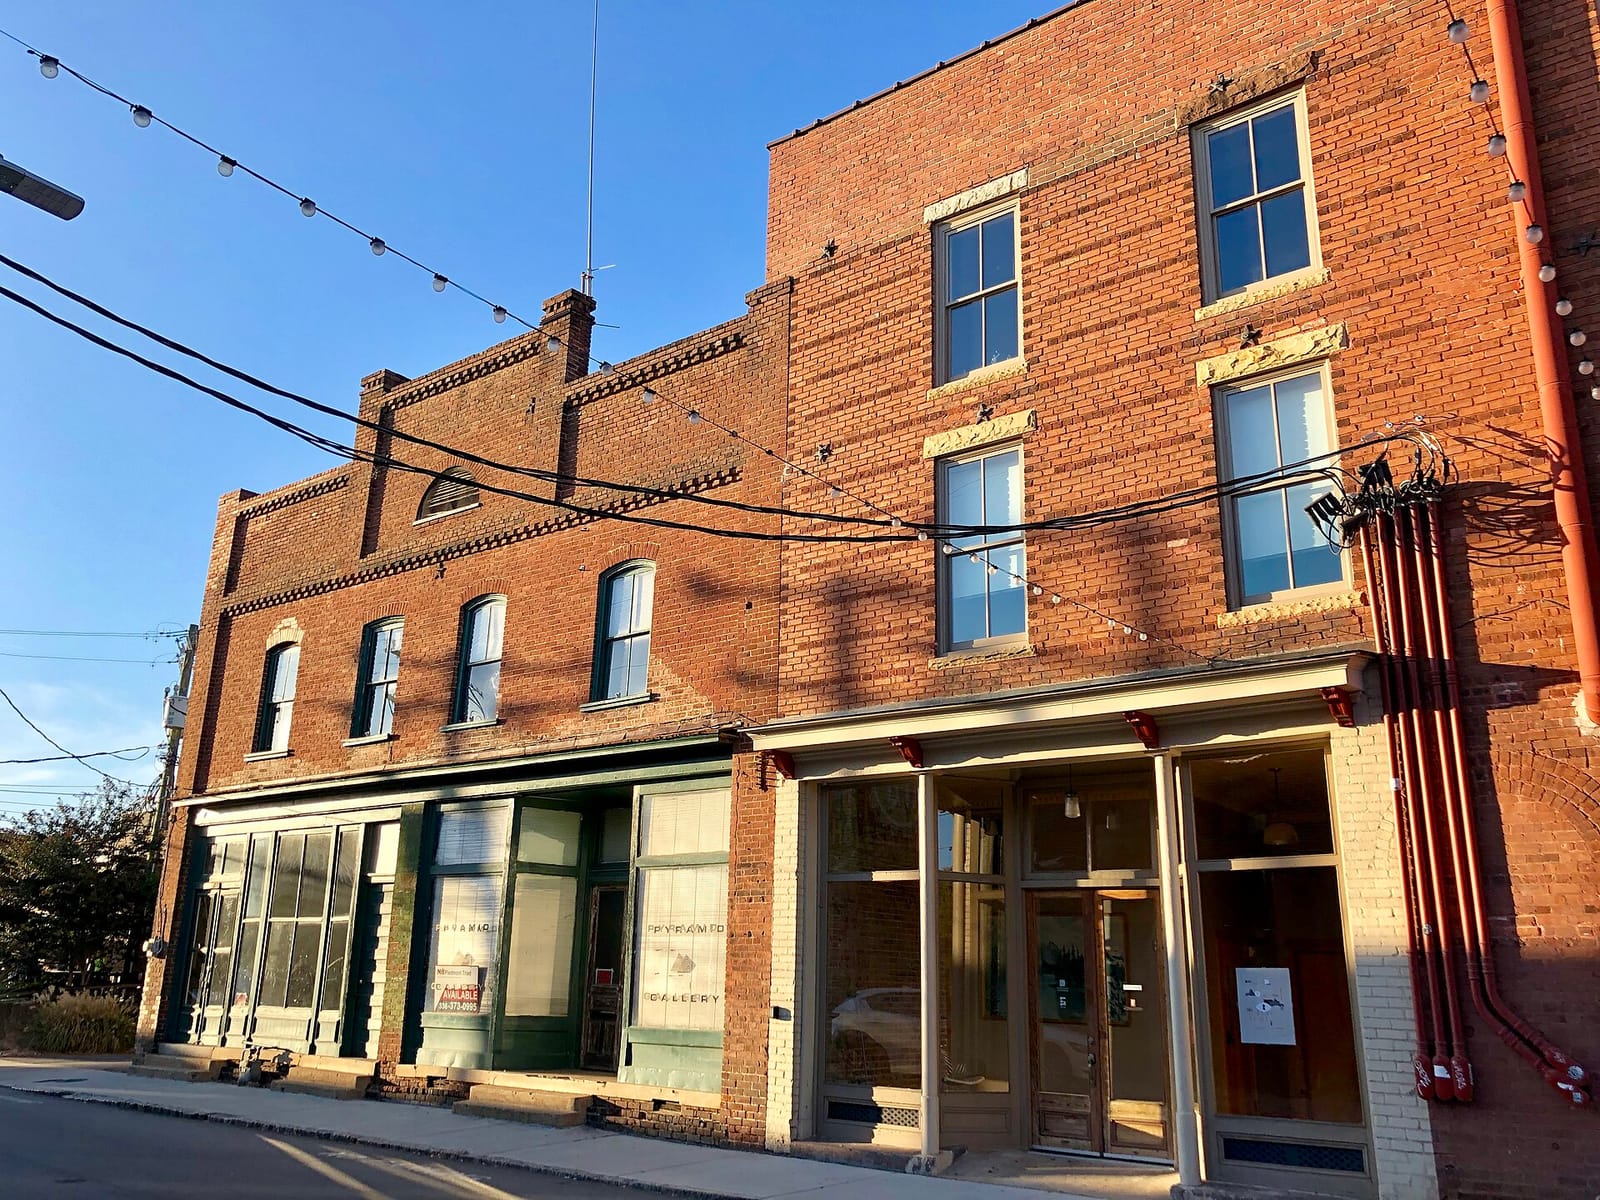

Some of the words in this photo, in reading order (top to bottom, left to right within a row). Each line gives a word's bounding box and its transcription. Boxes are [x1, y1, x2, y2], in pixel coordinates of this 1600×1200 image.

[648, 924, 725, 934] PYRAMID
[442, 989, 478, 1000] AVAILABLE
[647, 992, 720, 1003] GALLERY
